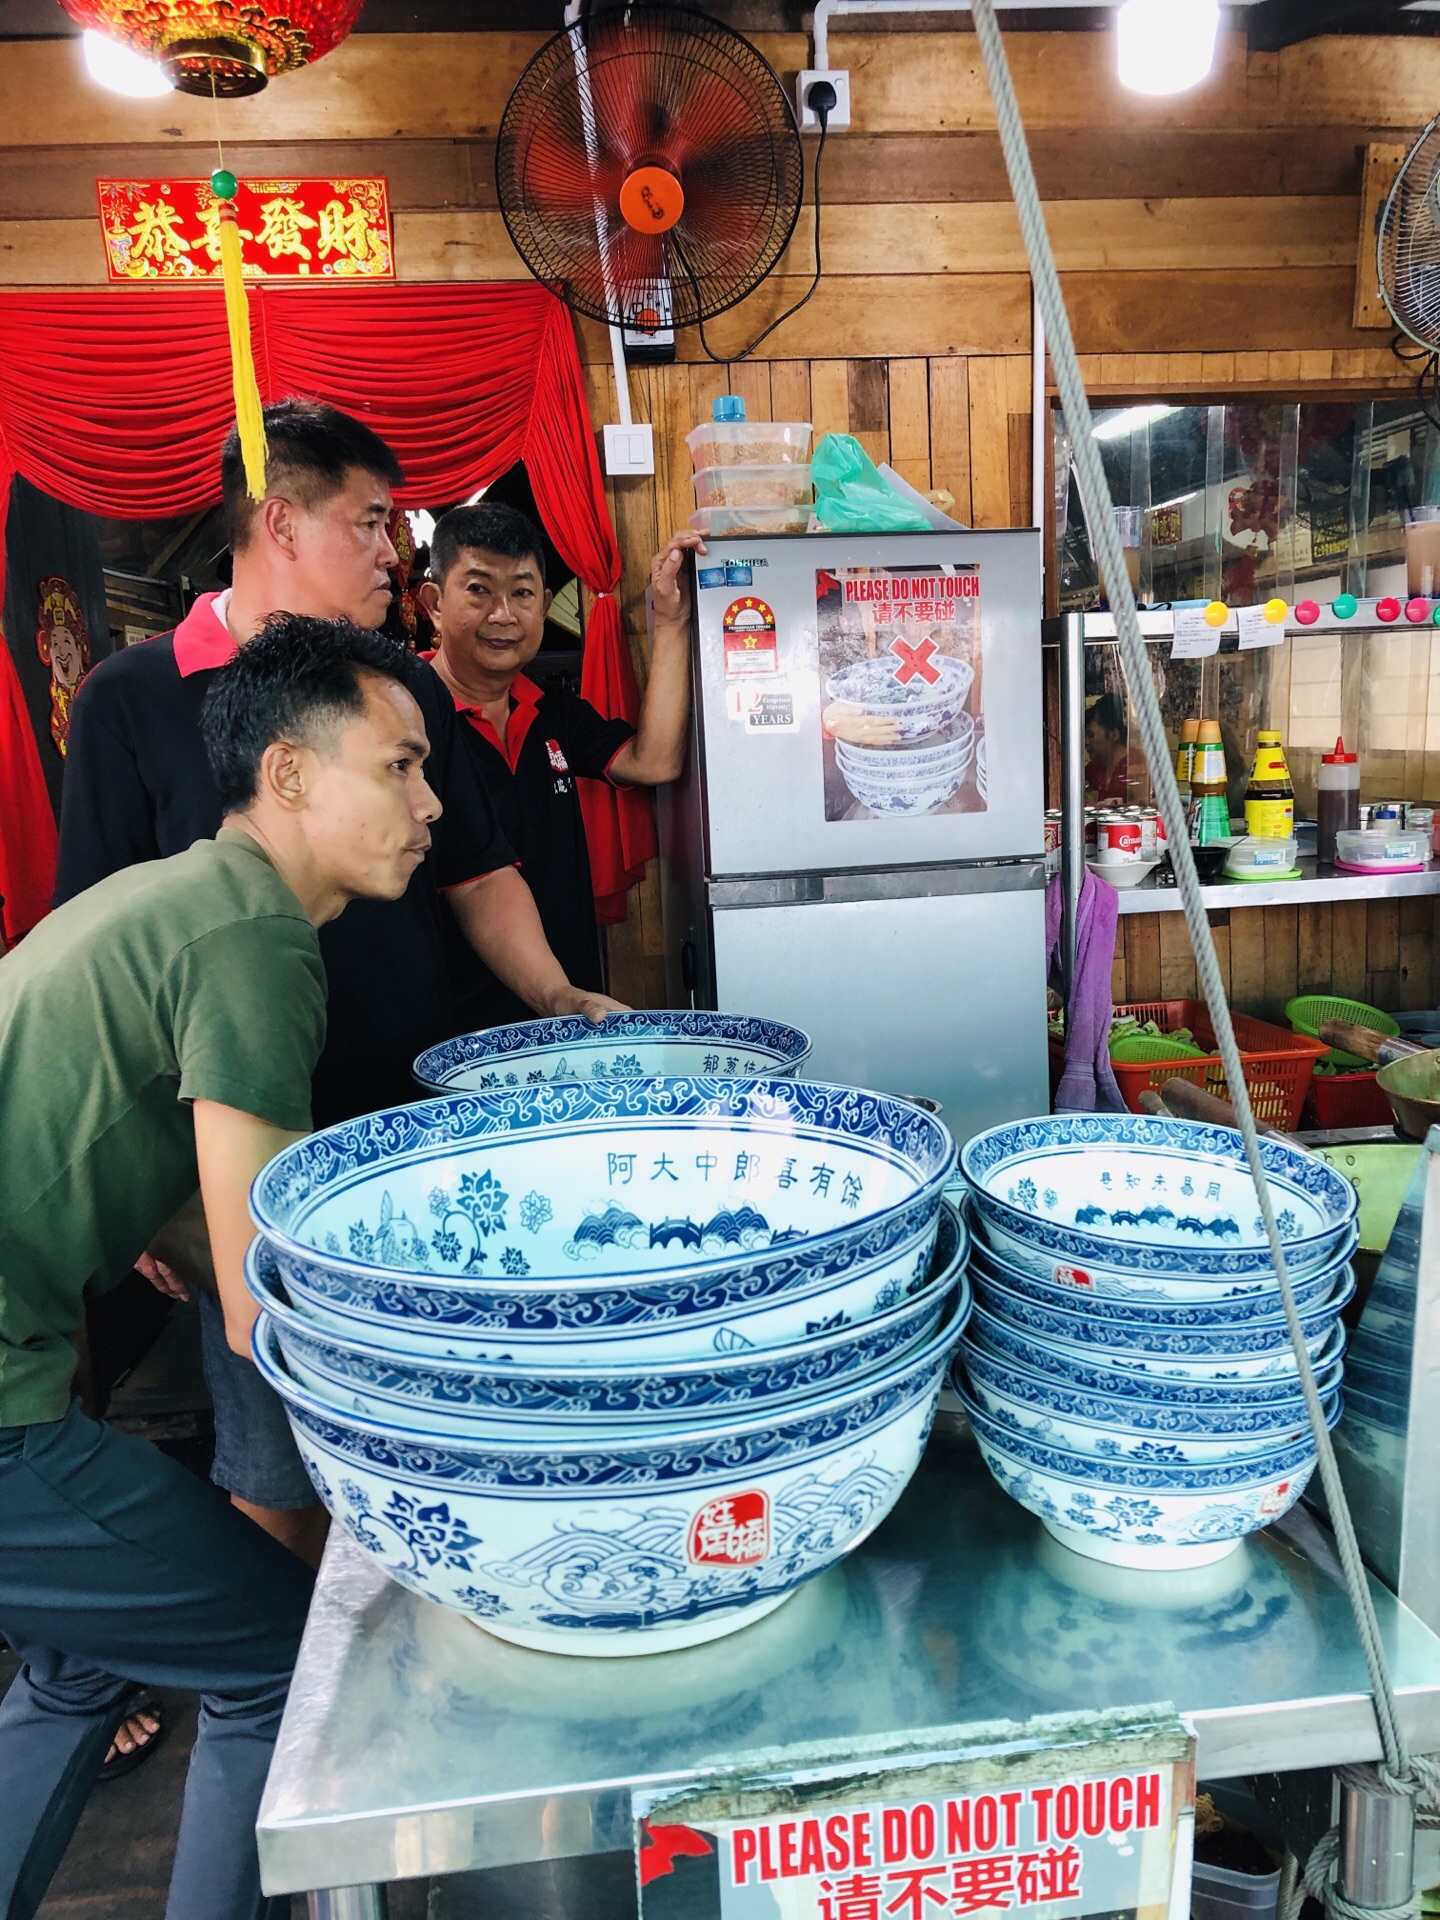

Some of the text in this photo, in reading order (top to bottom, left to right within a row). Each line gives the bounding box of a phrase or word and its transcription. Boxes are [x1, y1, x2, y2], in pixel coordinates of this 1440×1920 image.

[721, 558, 769, 568] TOSHIBA
[845, 575, 980, 602] PLEASE DO NOT TOUCH
[872, 600, 955, 625] 请不要碰
[753, 713, 791, 725] YEARS
[703, 1053, 769, 1075] 郁葱佳
[732, 1774, 1160, 1885] PLEASE DO NOT TOUCH
[818, 1845, 1081, 1920] 请不要碰
